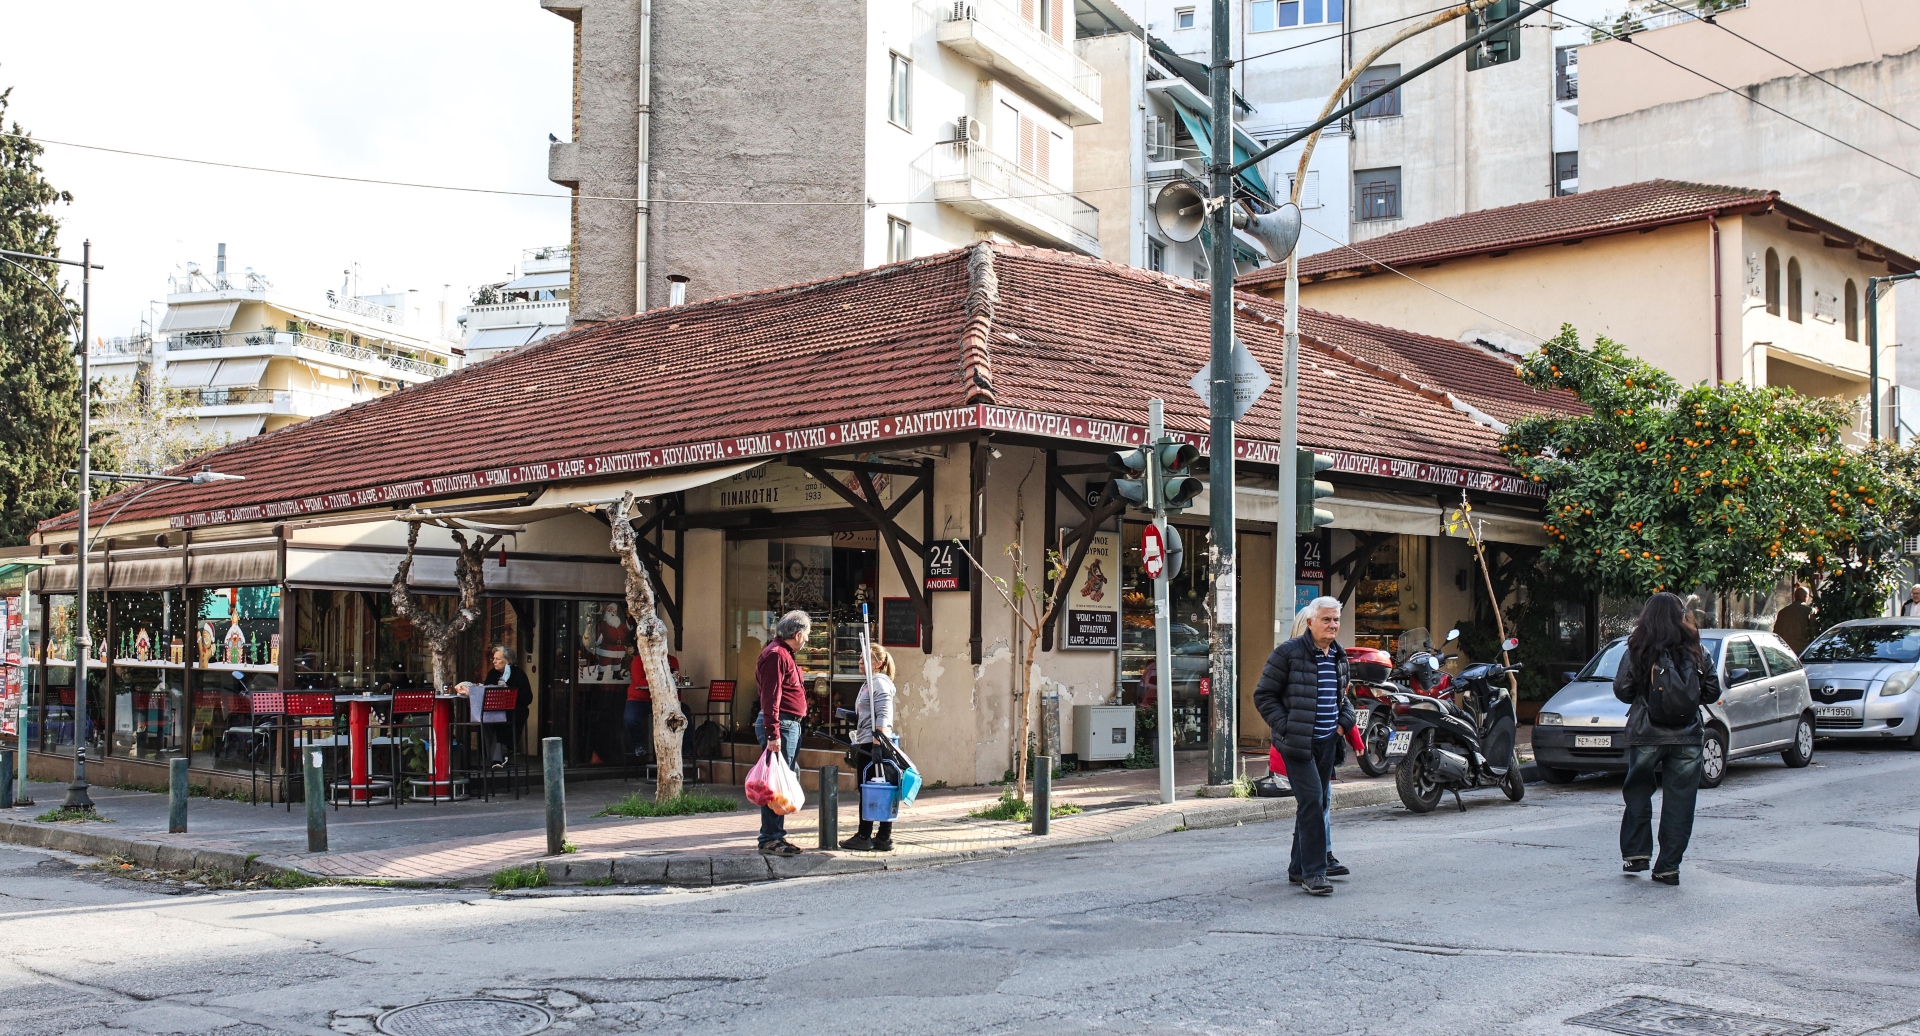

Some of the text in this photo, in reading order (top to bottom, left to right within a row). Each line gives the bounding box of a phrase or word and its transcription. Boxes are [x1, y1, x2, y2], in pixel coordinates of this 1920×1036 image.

[986, 407, 1072, 437] ΚΟΥΛΟΥΡΙΑ
[1088, 421, 1128, 444] ΨΩΜΙ
[1390, 460, 1420, 479] ΨΩΜΙ
[1428, 466, 1459, 485] ΓΛΥΚΟ
[1466, 471, 1494, 489] ΚΑΦΕ
[170, 406, 978, 527] ΨΩΜΙ ΓΛΥΚΟ ΚΑΦΕ ΣΑΝΤΟΥΙΤΣ ΚΟΥΛΟΥΡΙΑ ΨΩΜΙ ΓΛΥΚΟ ΚΑΦΕ ΣΑΝΤΟΥΙΤΣ ΚΟΥΛΟΥΡΙΑ ΨΩΜΙ ΓΛΥΚΟ ΚΑΦΕ ΣΑΝΤΟΥΙΤΣ ΚΟΥΛΟΥΡΙΑ ΨΩΜΙ ΓΛΥΚΟ ΚΑΦΕ ΣΑΝΤΟΥΙΤΣ
[720, 487, 779, 506] ΠΙΝΑΚΩΤΗΣ
[805, 491, 822, 501] 1933
[1304, 542, 1320, 560] 24
[930, 546, 952, 568] 24
[1301, 570, 1324, 579] ΑΝΟΙΧΤΑ
[926, 580, 956, 588] ΑΝΟΙΧΤΑ
[1076, 613, 1112, 622] ΨΩΜΙ ΓΛΥΚΟ
[1080, 624, 1108, 634] ΚΟΥΛΟΥΡΙΑ
[1070, 636, 1116, 645] ΚΑΦΕ ΣΑΝΤΟΥΙΤΣ
